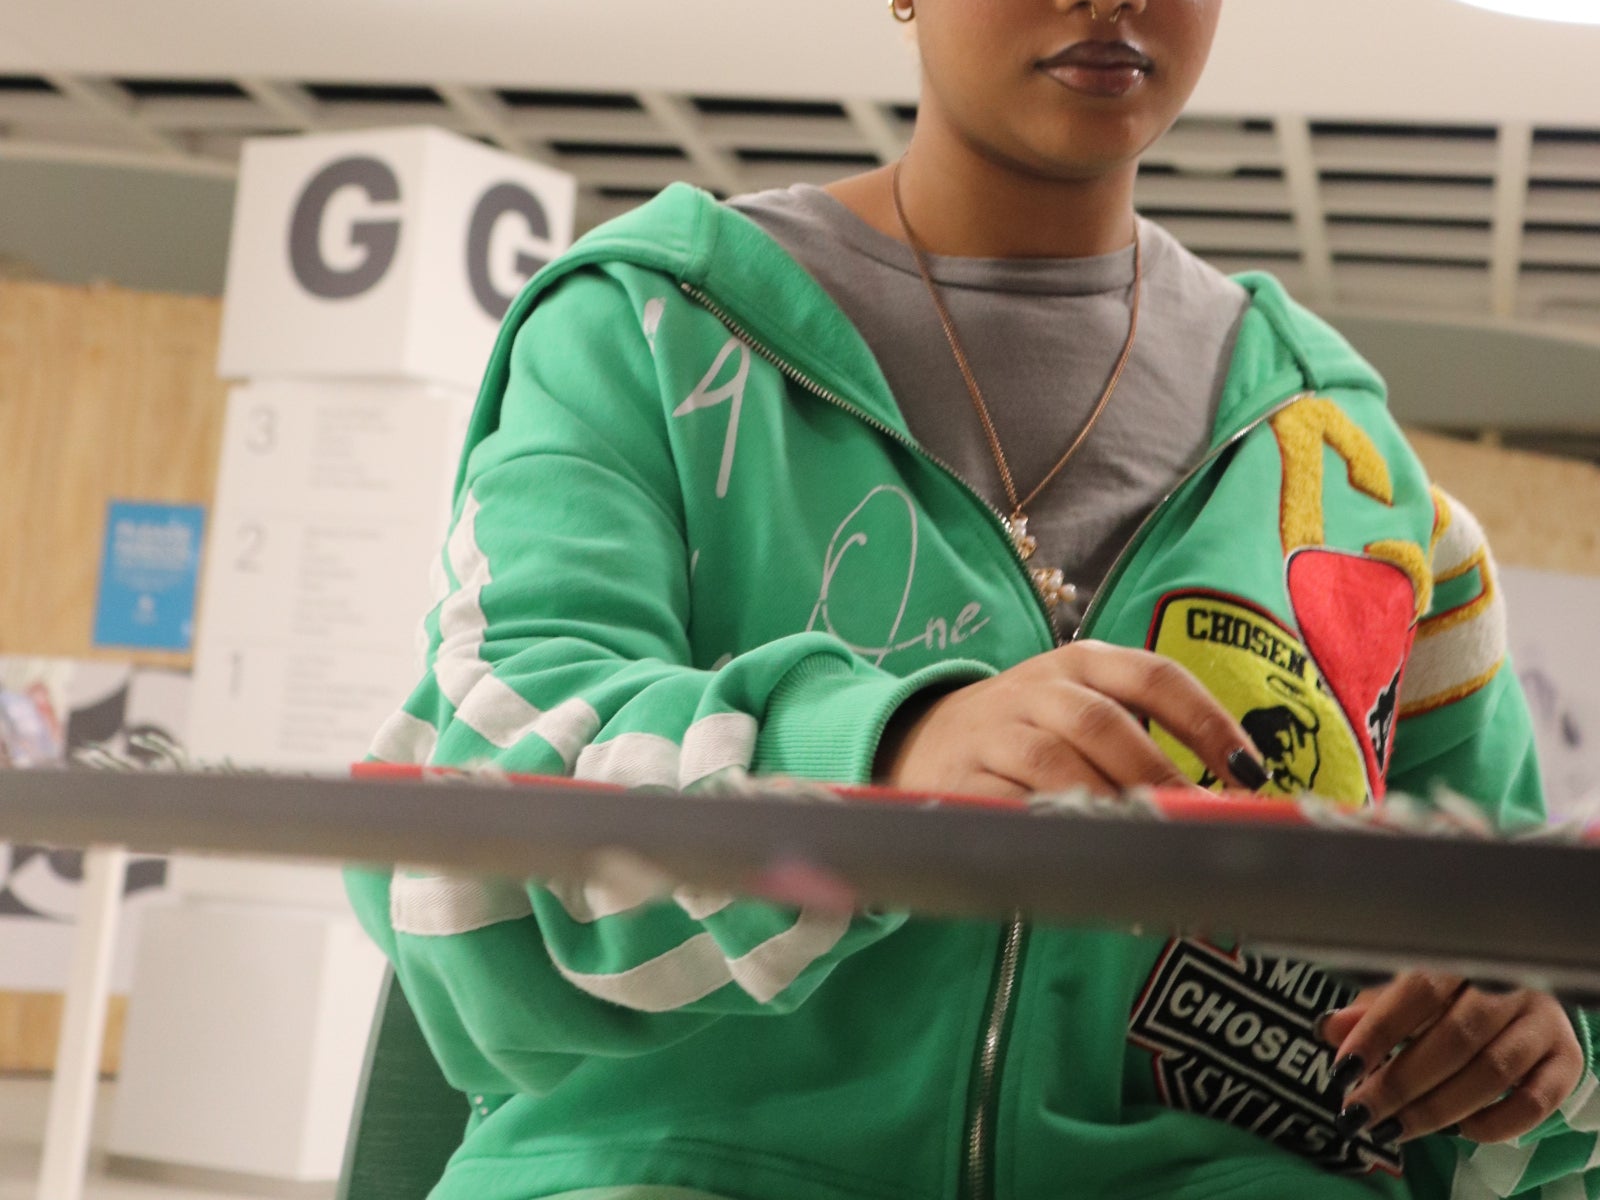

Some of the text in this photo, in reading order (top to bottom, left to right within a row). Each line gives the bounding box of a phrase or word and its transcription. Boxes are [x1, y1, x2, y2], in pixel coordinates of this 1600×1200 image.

[289, 155, 402, 300] G
[466, 181, 552, 324] G
[245, 405, 278, 454] 3
[234, 523, 267, 573] 2
[1187, 607, 1309, 680] CHOSEN
[1169, 980, 1336, 1095] CHOSEN
